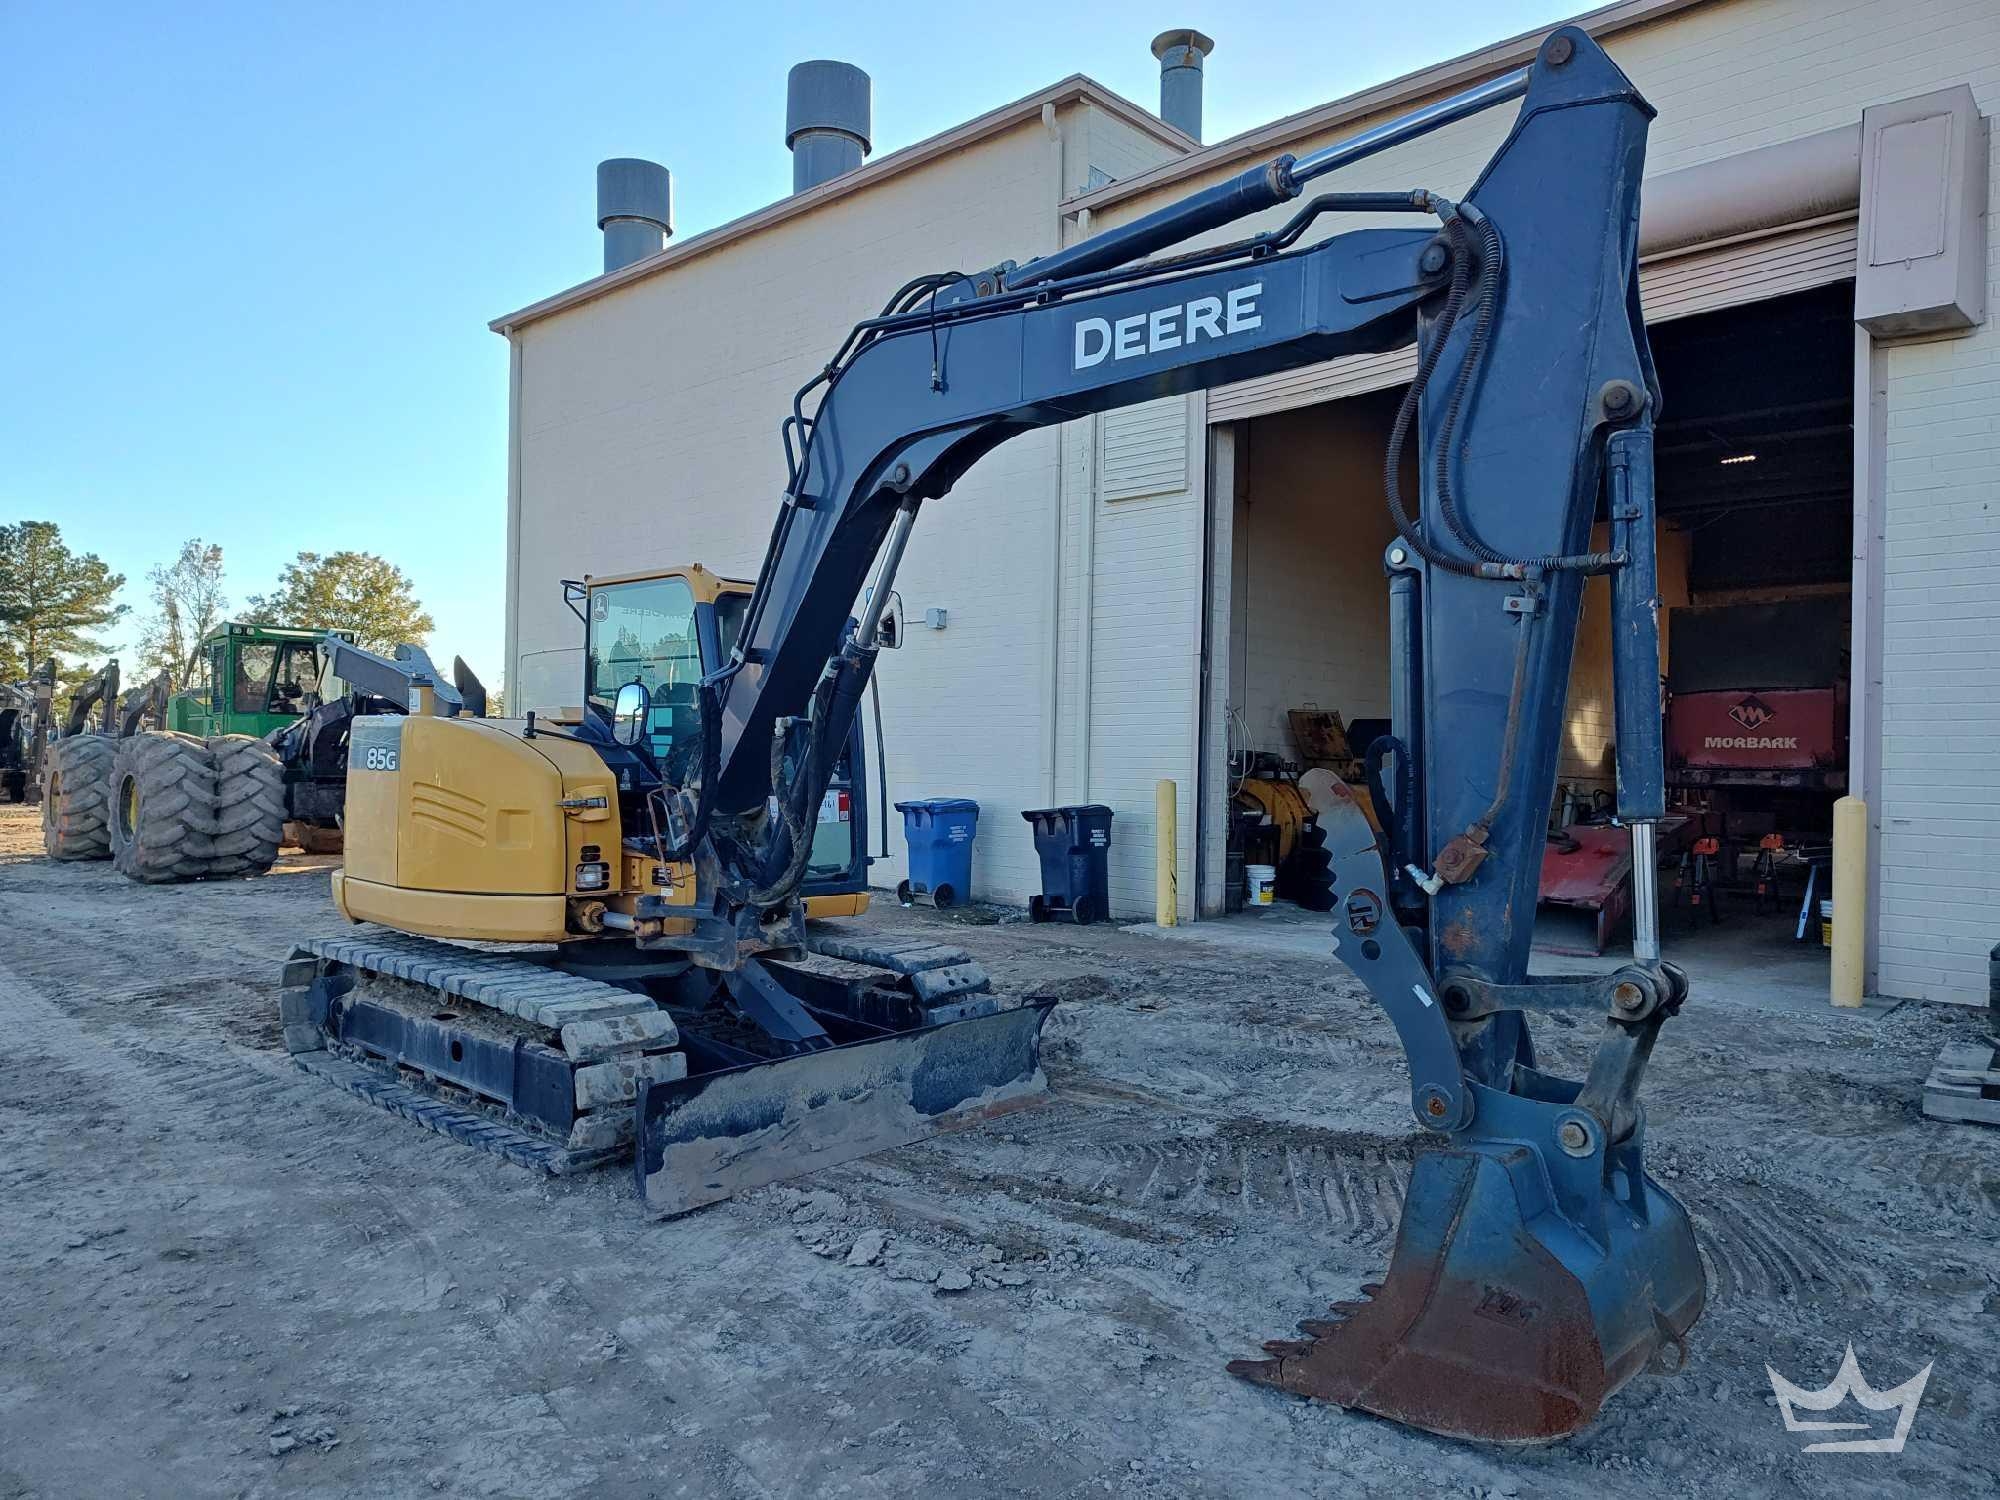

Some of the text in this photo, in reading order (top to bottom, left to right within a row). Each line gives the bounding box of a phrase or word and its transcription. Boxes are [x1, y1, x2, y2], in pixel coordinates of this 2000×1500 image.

[1075, 283, 1263, 370] DEERE
[1704, 736, 1798, 749] MORBARK
[366, 747, 397, 770] 85G
